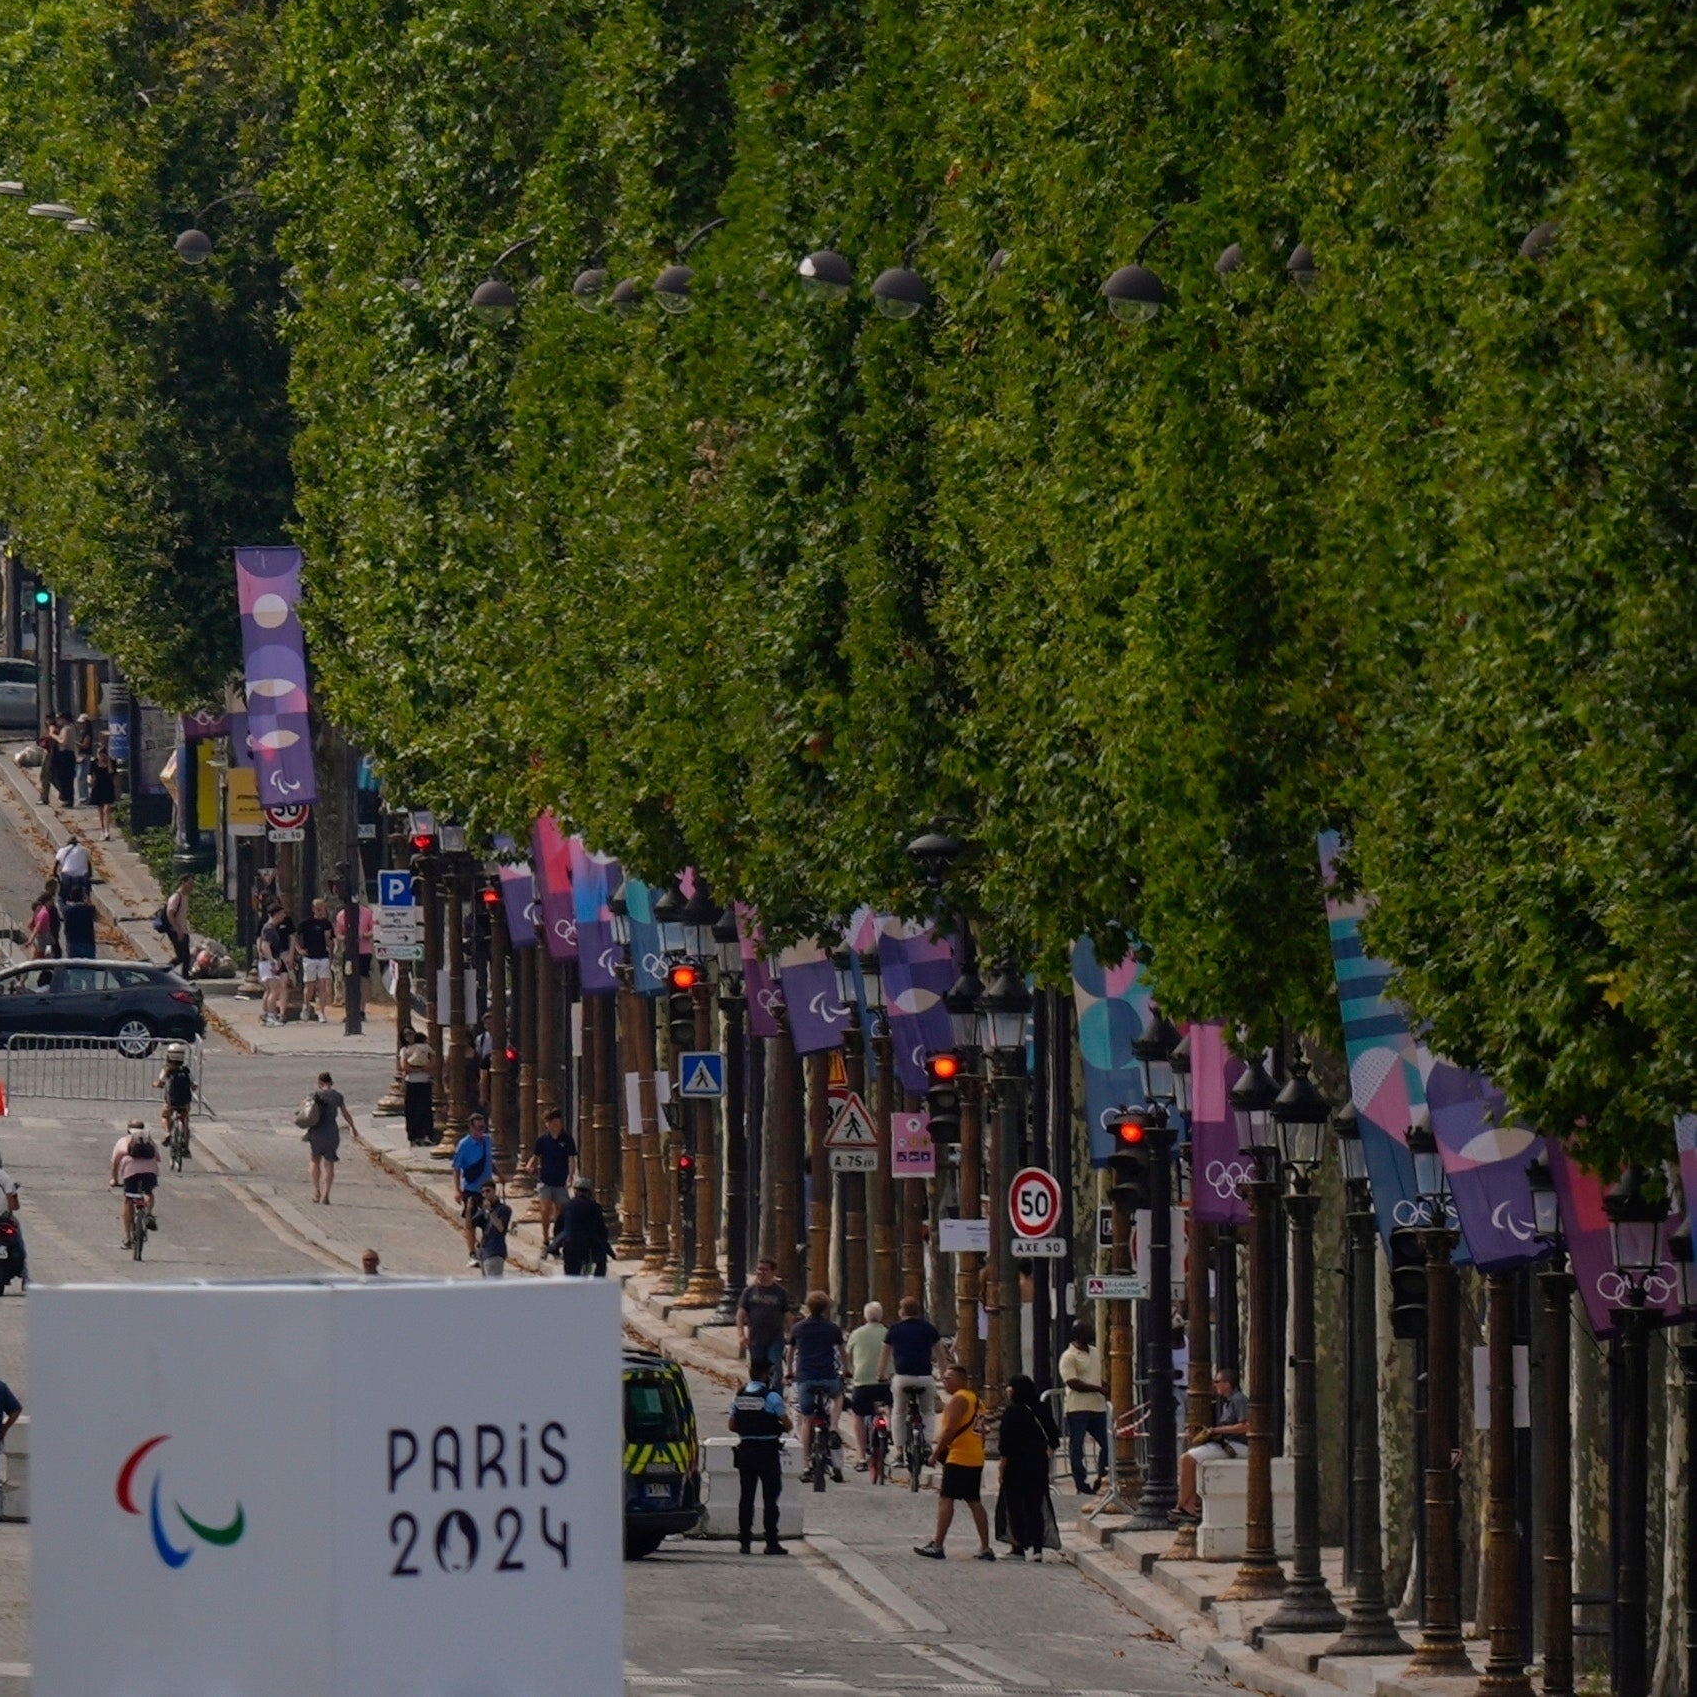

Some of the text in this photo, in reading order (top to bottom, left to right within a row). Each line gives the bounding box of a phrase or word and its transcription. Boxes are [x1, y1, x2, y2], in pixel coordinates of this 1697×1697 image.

[388, 878, 405, 902] P
[1021, 1190, 1048, 1217] 50
[1016, 1242, 1060, 1253] AXE 50
[389, 1505, 570, 1576] 2024
